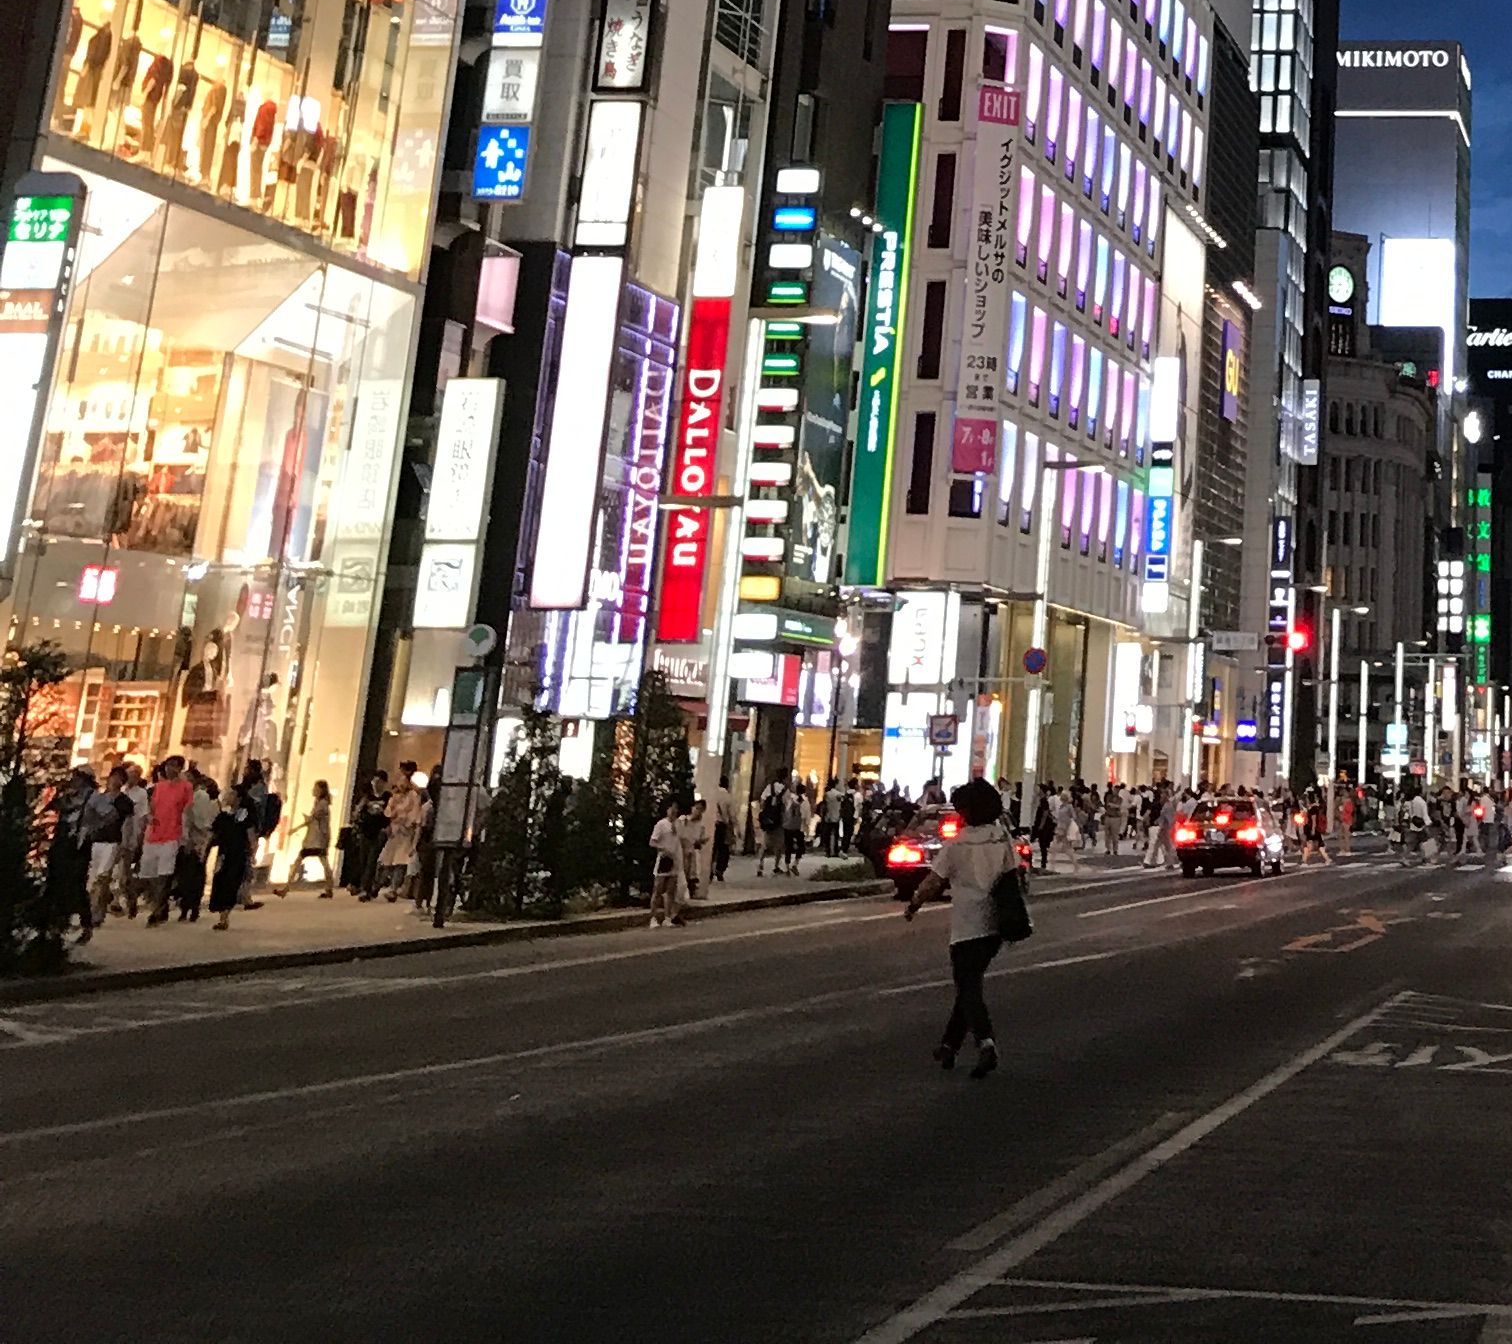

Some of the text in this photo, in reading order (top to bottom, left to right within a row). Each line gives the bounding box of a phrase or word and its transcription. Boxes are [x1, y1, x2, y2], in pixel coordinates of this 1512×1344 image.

[626, 10, 644, 72] うなぎ
[1335, 50, 1450, 68] MIKIMOTO
[983, 92, 1019, 123] EXIT
[873, 231, 899, 356] PRESTIA
[1225, 348, 1240, 396] GU
[1303, 389, 1319, 457] TASAKI
[670, 367, 721, 568] DALLOAU
